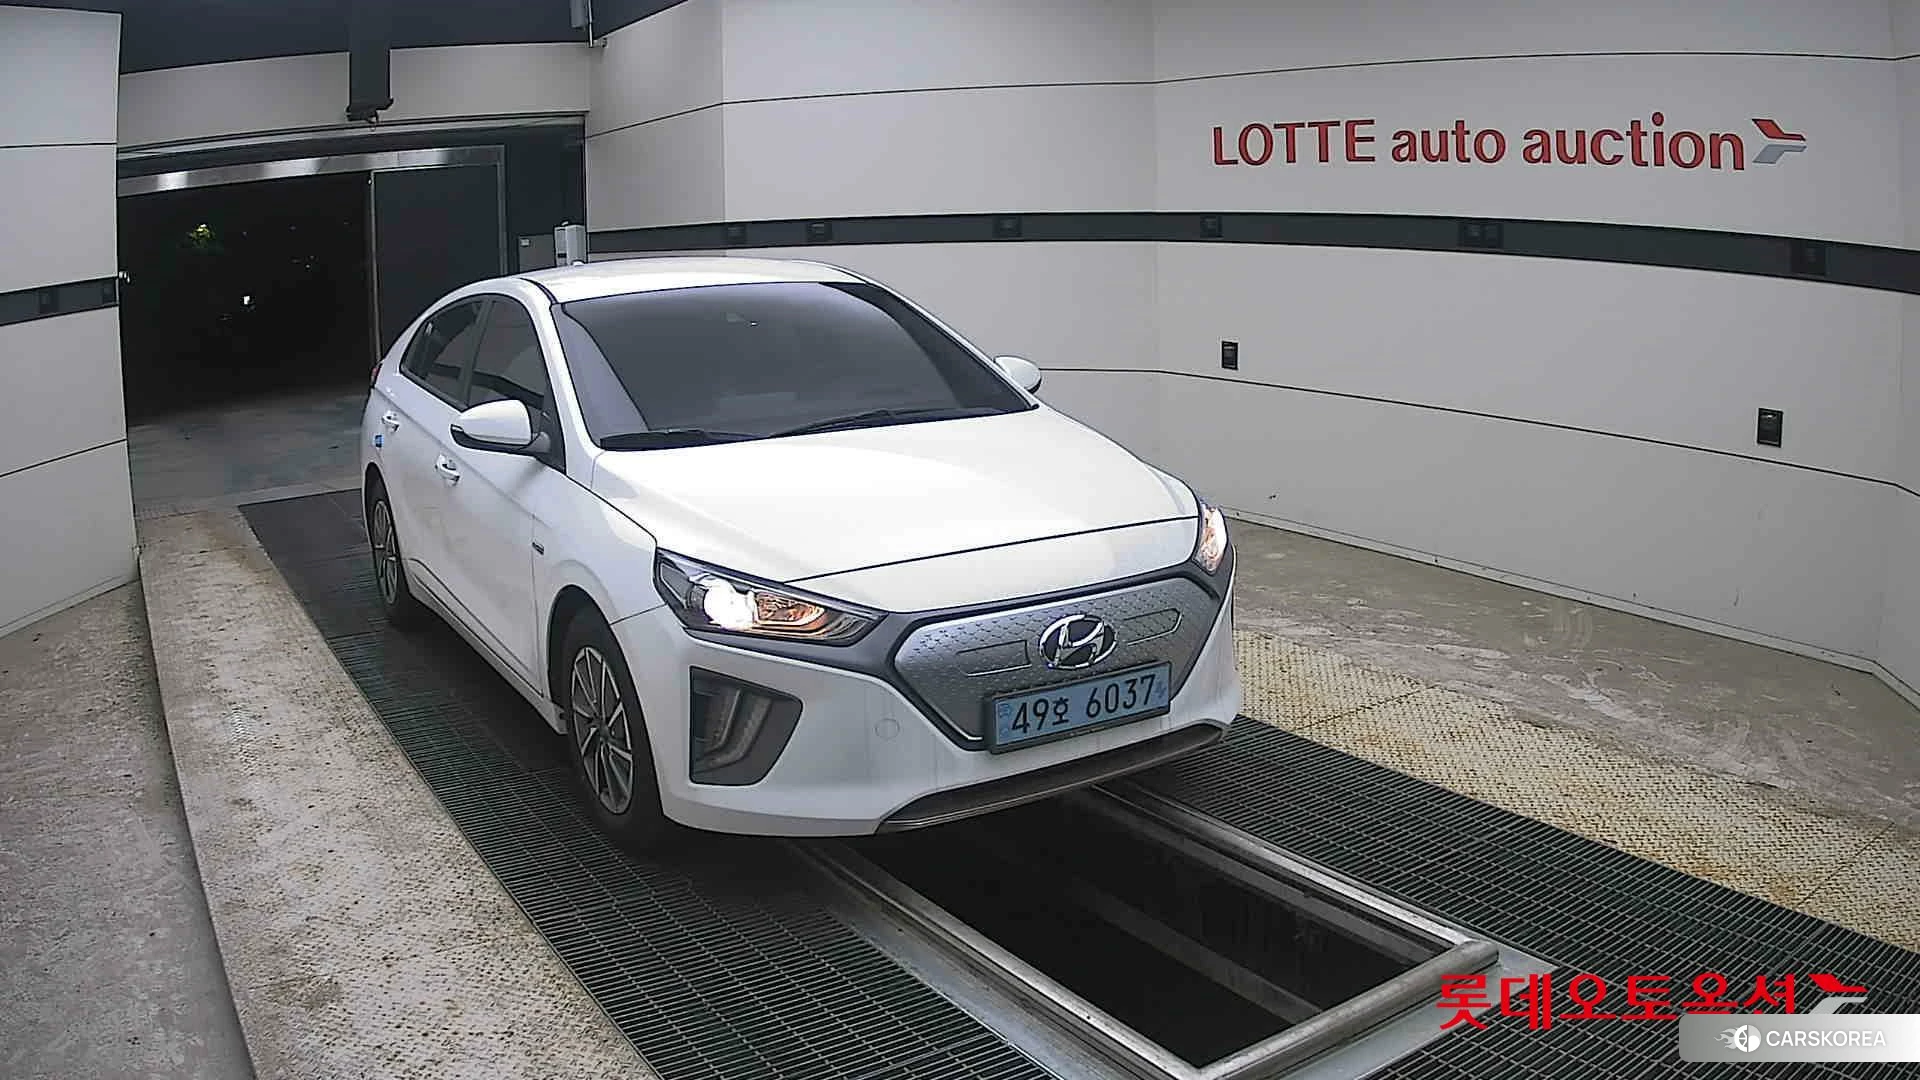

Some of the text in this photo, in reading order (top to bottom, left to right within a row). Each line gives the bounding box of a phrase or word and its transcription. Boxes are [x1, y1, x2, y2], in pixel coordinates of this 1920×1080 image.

[1213, 112, 1746, 170] LOTTE auto auction
[1011, 674, 1156, 734] 49호 6037
